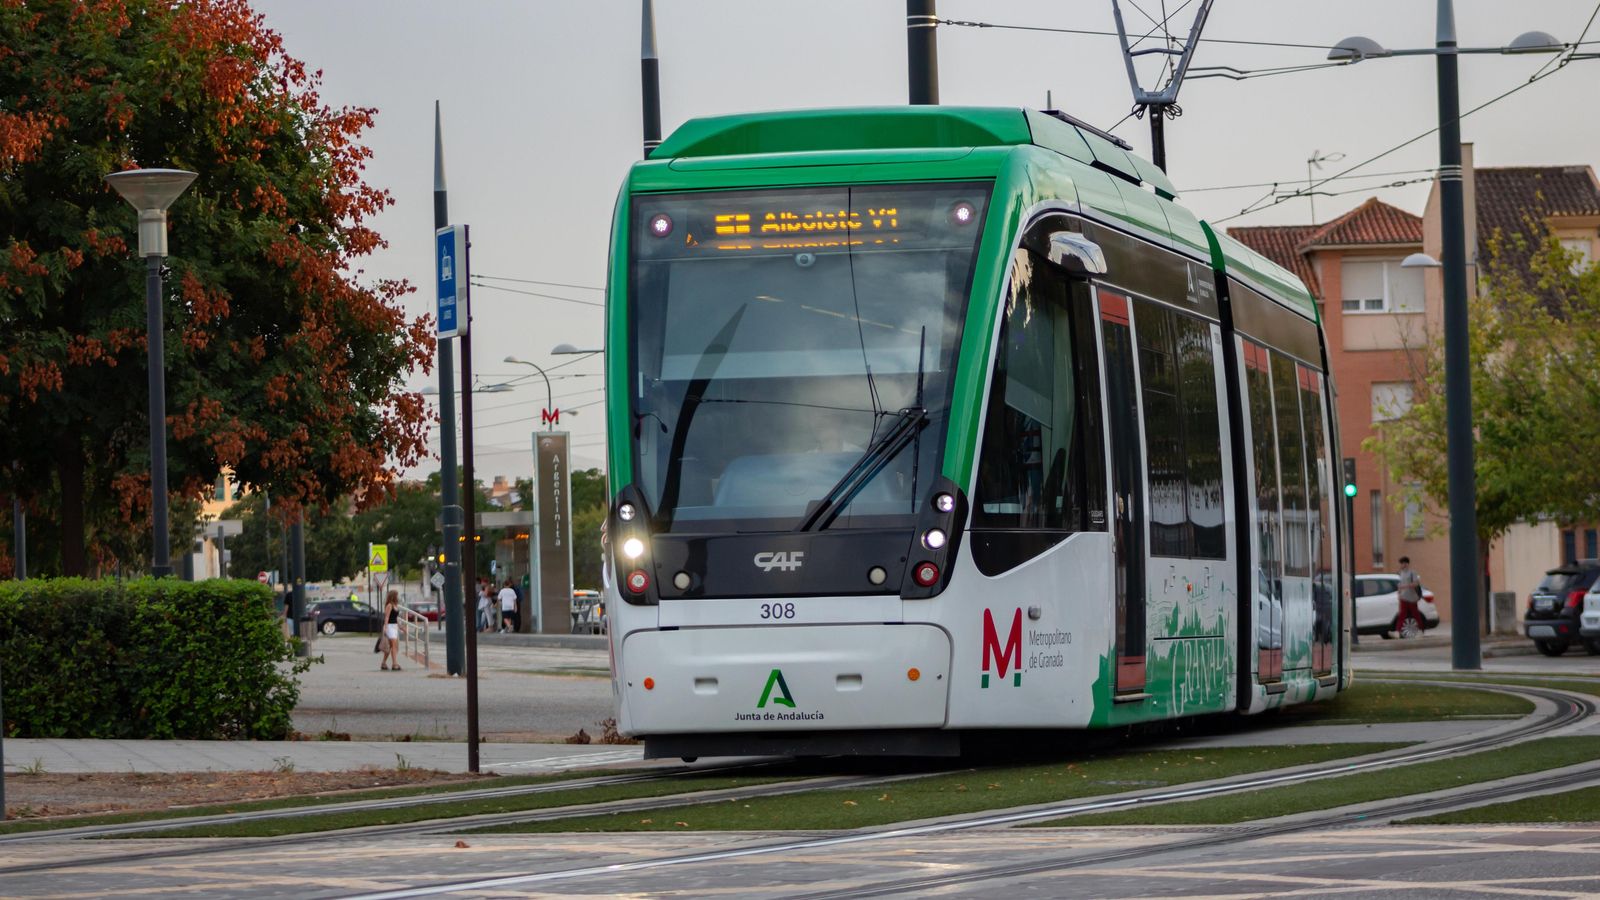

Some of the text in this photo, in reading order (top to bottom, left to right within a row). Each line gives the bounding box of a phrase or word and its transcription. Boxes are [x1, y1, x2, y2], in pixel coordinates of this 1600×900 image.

[552, 454, 561, 546] Argentinita
[754, 551, 804, 572] CAF
[760, 603, 795, 619] 308
[1028, 628, 1072, 648] Metropolitano
[1029, 650, 1064, 668] de Granada
[735, 710, 825, 721] Junta de Andalucía
